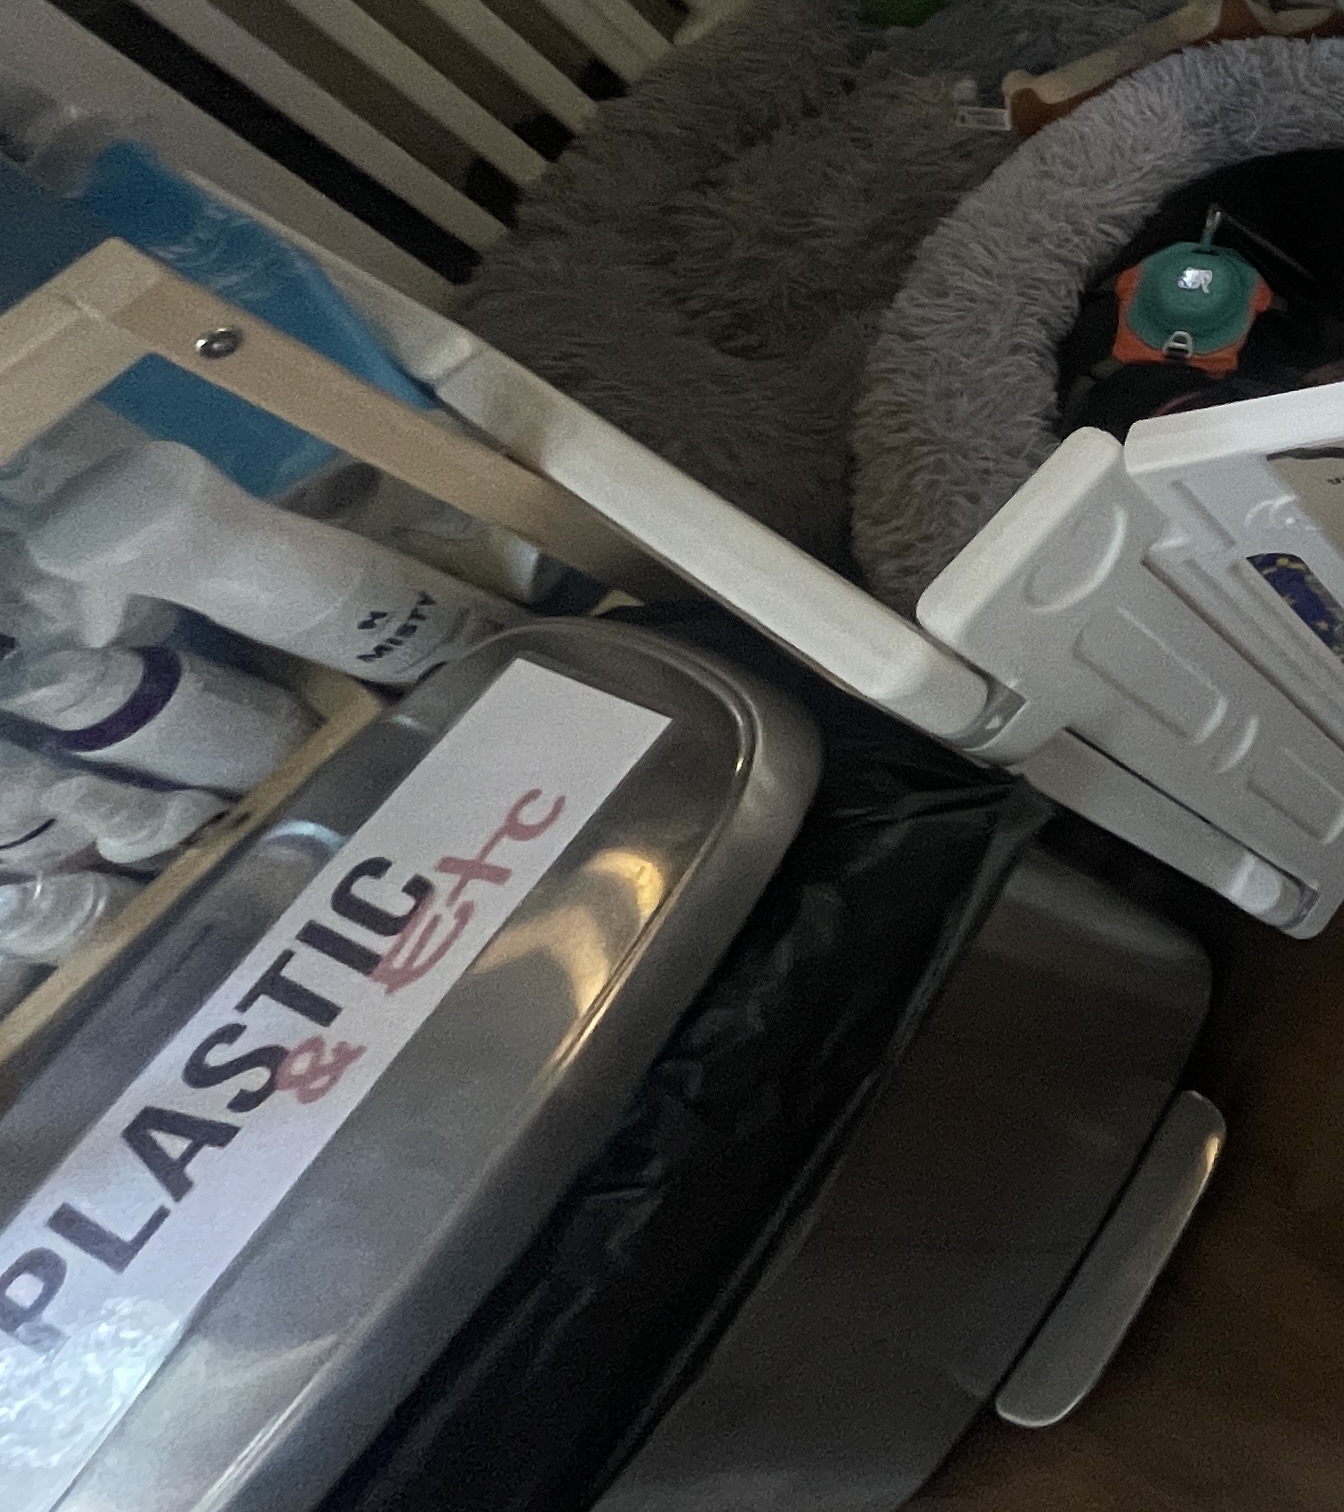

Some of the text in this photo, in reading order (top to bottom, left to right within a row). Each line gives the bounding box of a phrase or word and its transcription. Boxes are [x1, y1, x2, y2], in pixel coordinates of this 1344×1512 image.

[357, 592, 436, 663] MISTY
[0, 854, 436, 1356] PLASTIC
[274, 1036, 368, 1105] &
